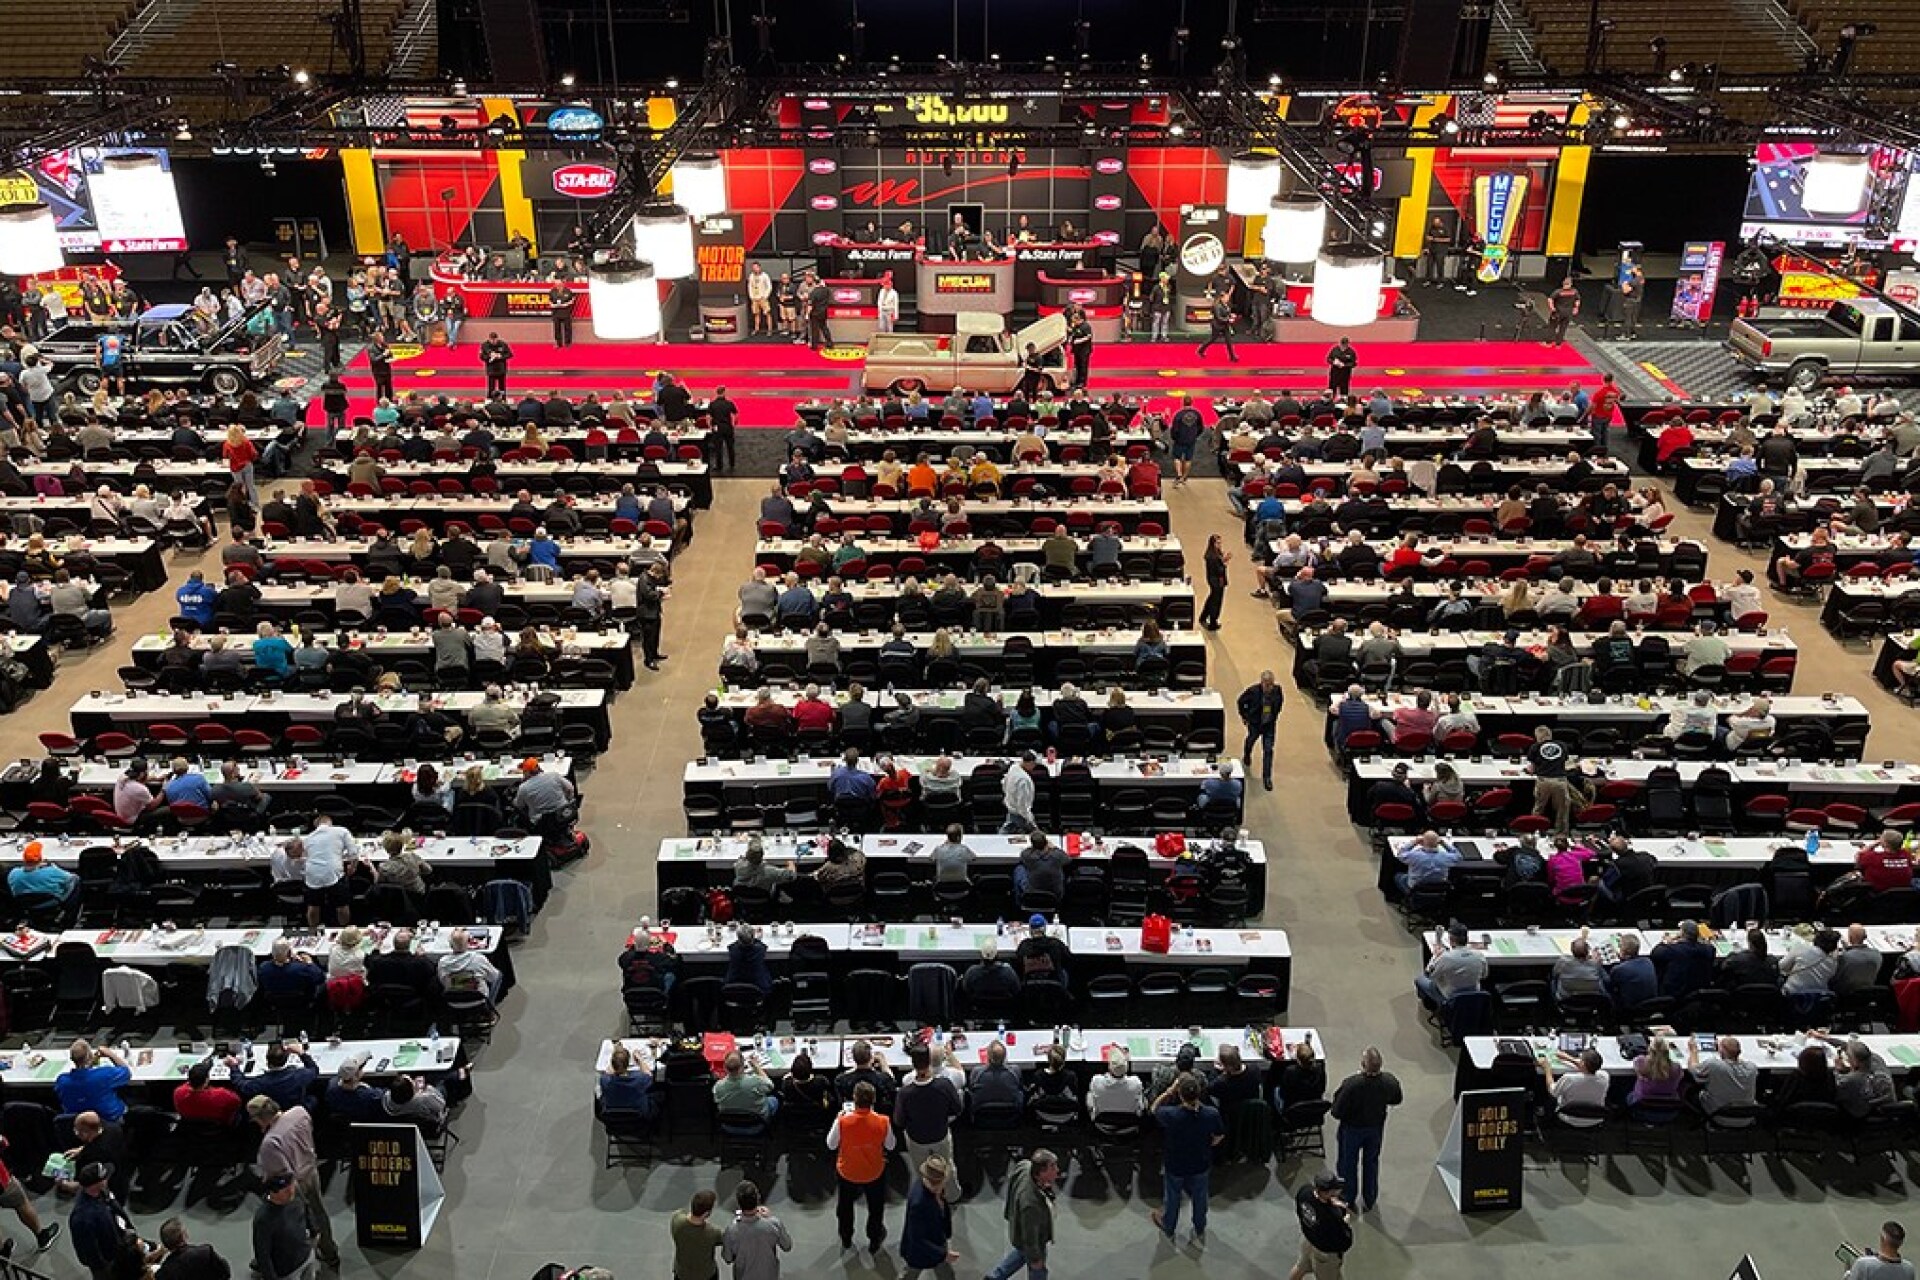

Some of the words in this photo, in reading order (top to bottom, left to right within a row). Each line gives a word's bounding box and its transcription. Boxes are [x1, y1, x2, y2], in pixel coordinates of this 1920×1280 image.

[698, 246, 745, 264] MOTOR
[701, 264, 743, 282] TREND
[1477, 1105, 1508, 1121] GOLD
[1466, 1120, 1518, 1137] BIDDERS
[368, 1140, 401, 1156] GOLD
[1477, 1136, 1508, 1151] ONLY
[357, 1155, 412, 1171] BIDDERS
[371, 1171, 402, 1186] ONLY
